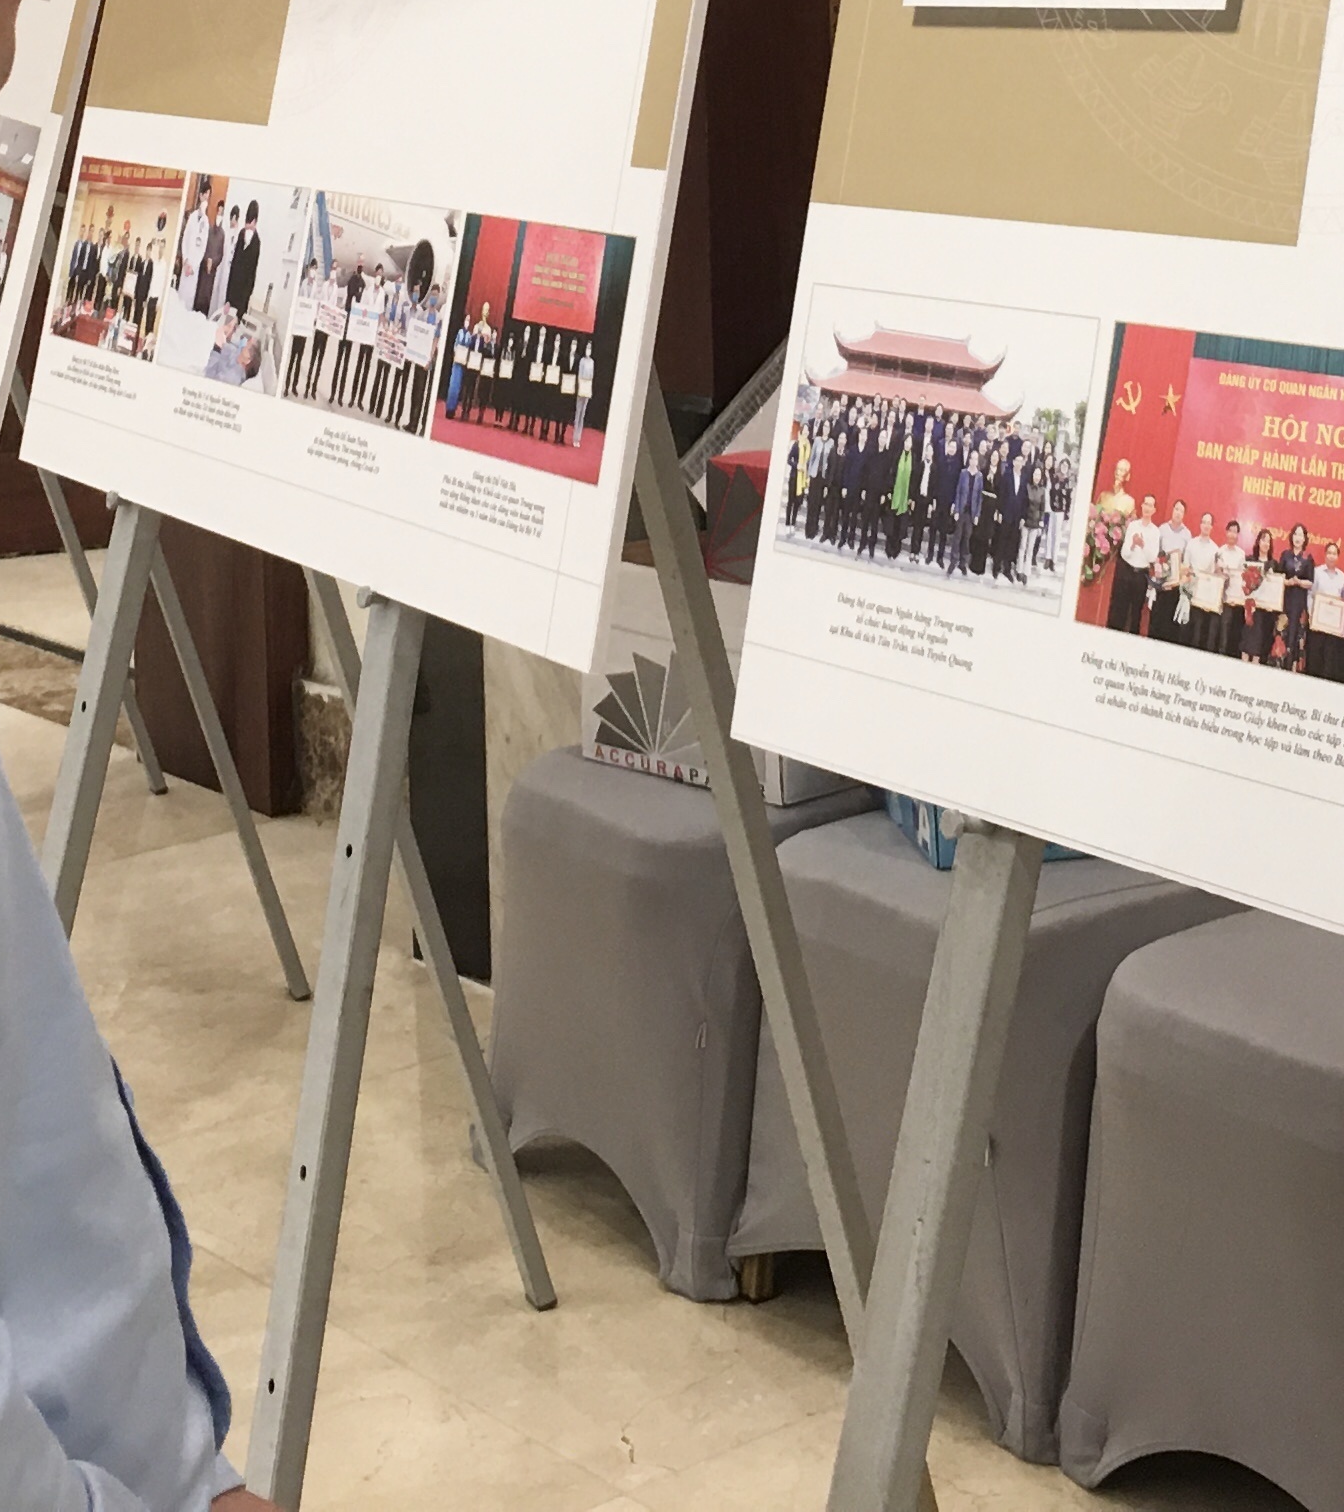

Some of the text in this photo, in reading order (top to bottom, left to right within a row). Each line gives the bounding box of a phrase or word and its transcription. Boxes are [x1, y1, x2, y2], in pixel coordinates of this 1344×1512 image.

[1262, 415, 1308, 445] HỘI
[1196, 440, 1223, 461] BAN
[1225, 445, 1260, 466] CHẤP
[1262, 451, 1298, 473] HÀNH
[1301, 455, 1327, 478] LẦN
[1242, 475, 1285, 500] NHIỆM
[1287, 483, 1305, 502] KỲ
[1308, 487, 1342, 509] 2020
